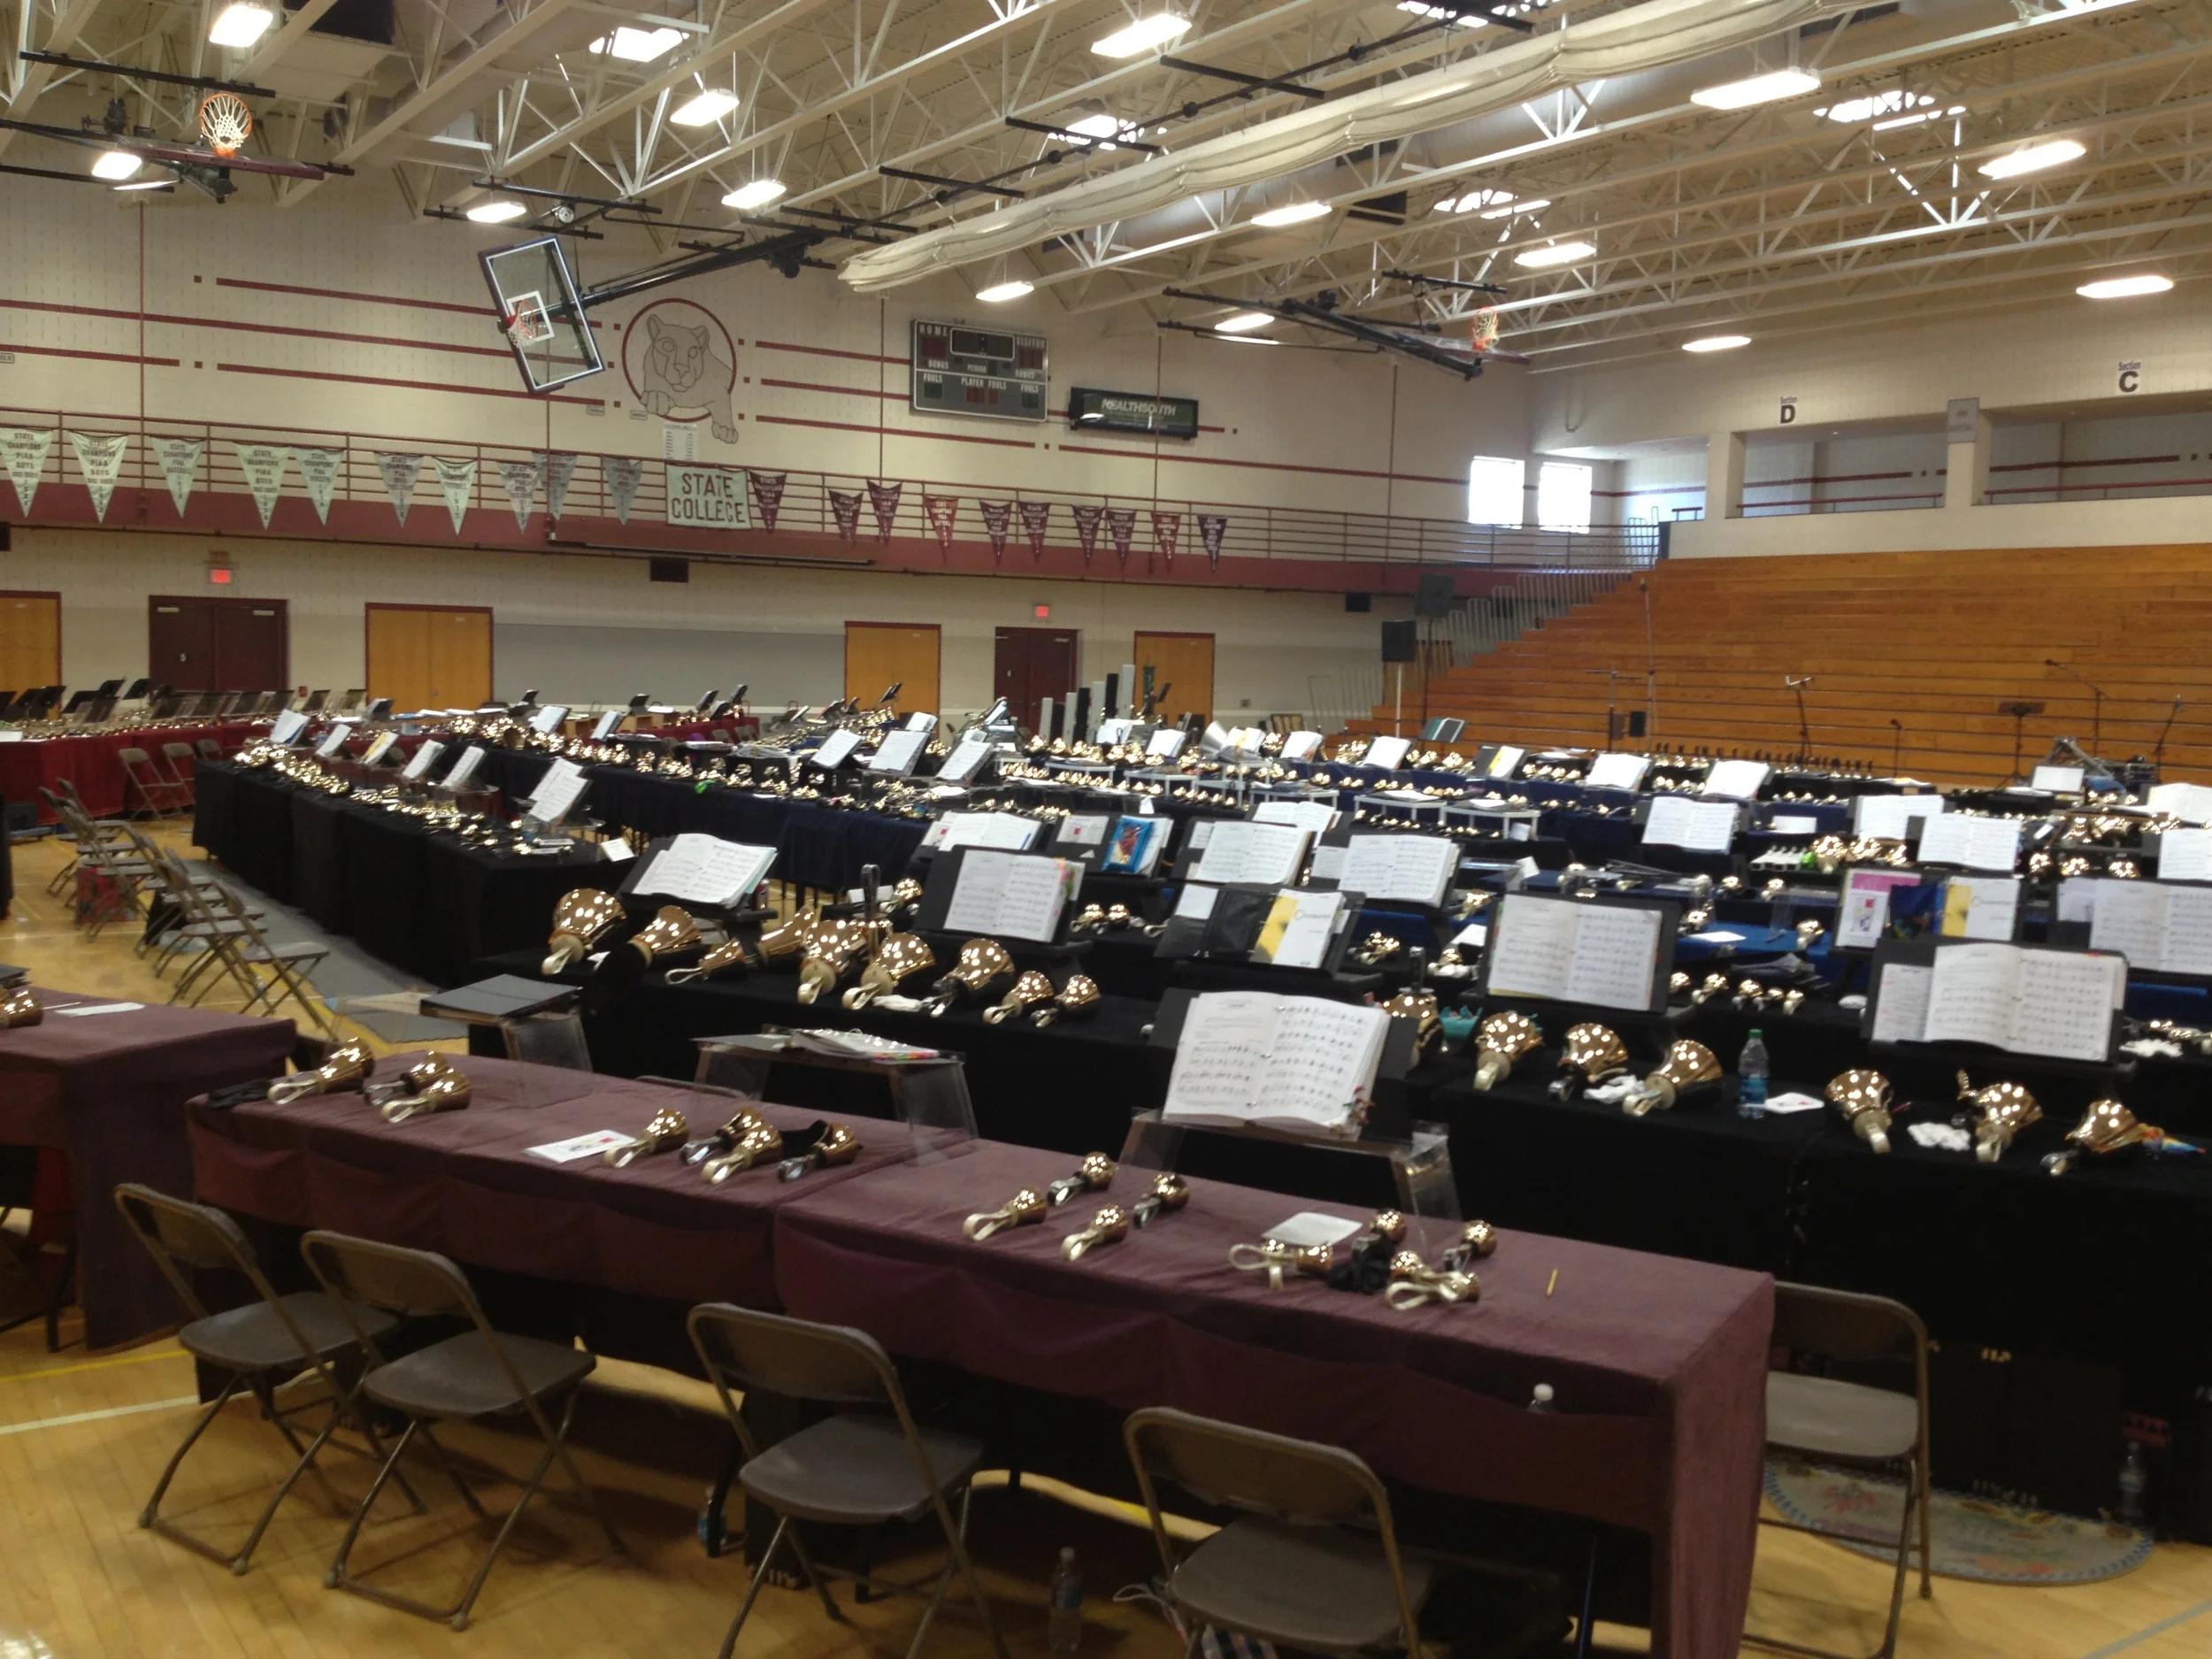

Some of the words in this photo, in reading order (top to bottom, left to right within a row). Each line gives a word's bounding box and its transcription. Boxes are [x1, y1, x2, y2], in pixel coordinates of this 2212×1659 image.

[919, 325, 949, 337] HOME
[1016, 336, 1046, 349] VISITOR
[928, 359, 949, 370] BONUS
[967, 364, 987, 373] PERIOD
[923, 373, 943, 383] FOULS
[961, 377, 985, 388] PLAYER
[988, 380, 1007, 390] FOULS
[2118, 370, 2139, 394] C
[1020, 383, 1040, 394] FOULS
[1779, 403, 1796, 424] D
[681, 472, 733, 498] STATE
[672, 498, 746, 524] COLLEGE
